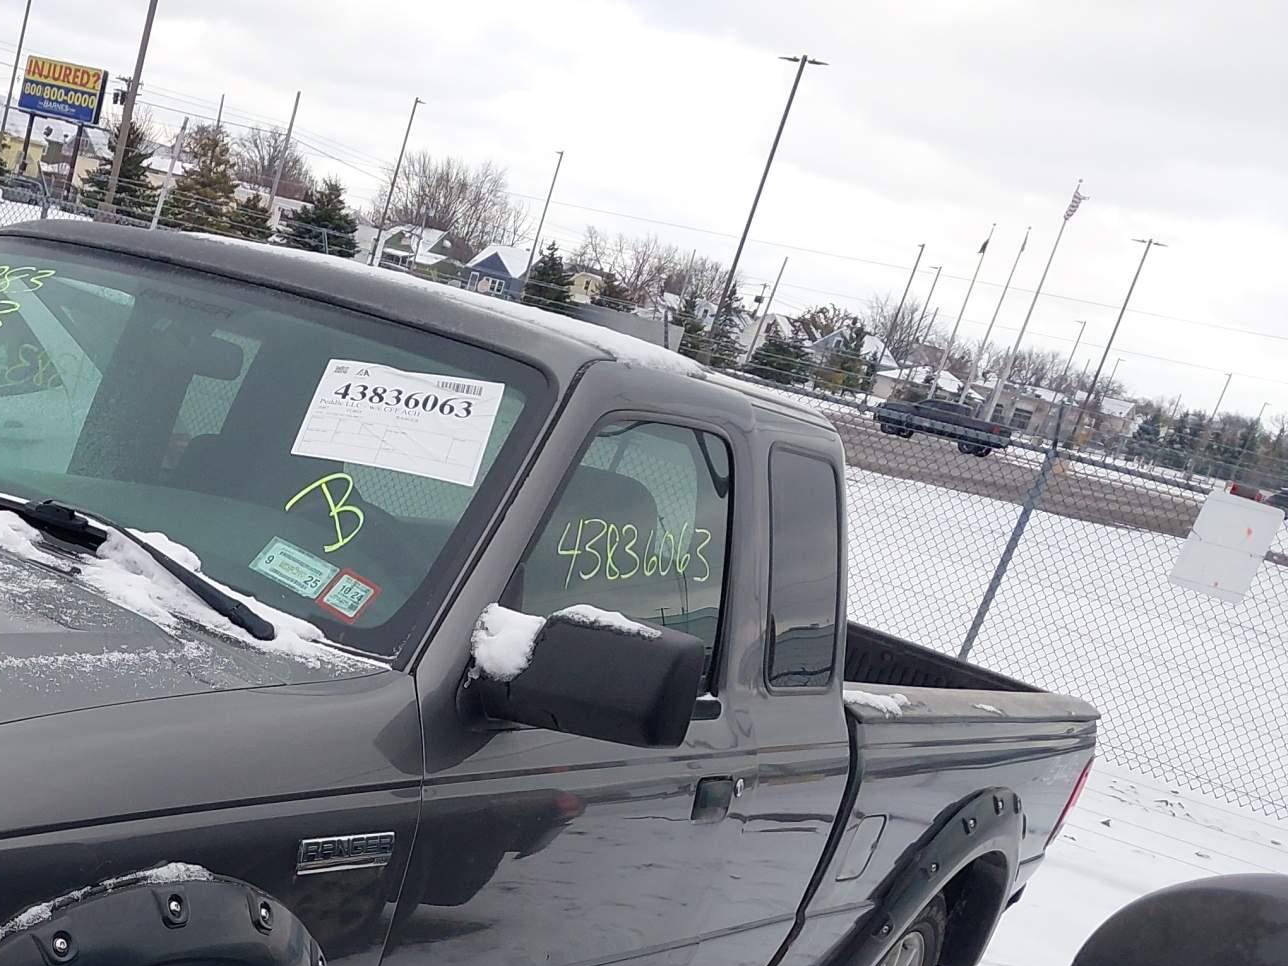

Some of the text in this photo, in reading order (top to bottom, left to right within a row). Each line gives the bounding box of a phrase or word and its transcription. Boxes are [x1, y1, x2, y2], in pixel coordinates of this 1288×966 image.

[26, 58, 101, 90] INJURED?
[333, 382, 474, 419] 43836063
[284, 472, 364, 553] B
[557, 518, 712, 590] 43836063
[303, 575, 321, 589] 25
[302, 835, 394, 862] RANGER
